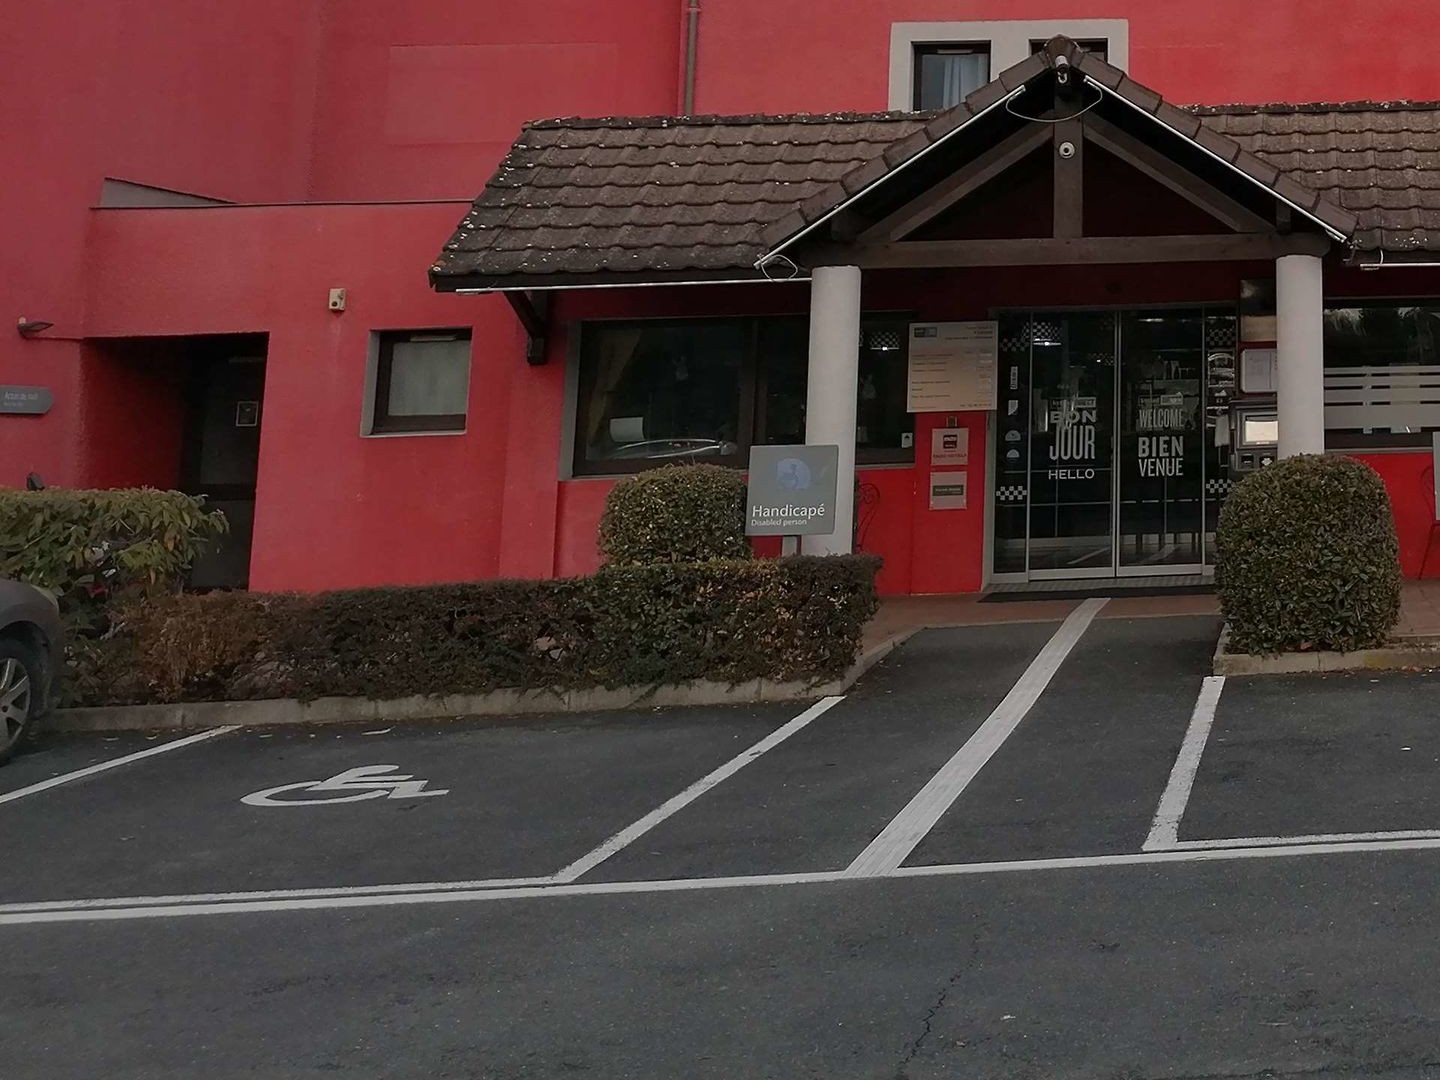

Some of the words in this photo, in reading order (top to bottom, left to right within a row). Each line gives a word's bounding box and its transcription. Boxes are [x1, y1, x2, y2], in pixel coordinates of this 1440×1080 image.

[1050, 410, 1097, 424] BON
[1138, 408, 1184, 428] WELCOME
[1049, 425, 1096, 461] JOUR
[1138, 435, 1184, 458] BIEN
[1048, 468, 1096, 480] HELLO
[1138, 458, 1184, 477] VENUE
[752, 503, 825, 519] Handicapé
[751, 519, 782, 527] Disabled
[783, 518, 808, 527] person
